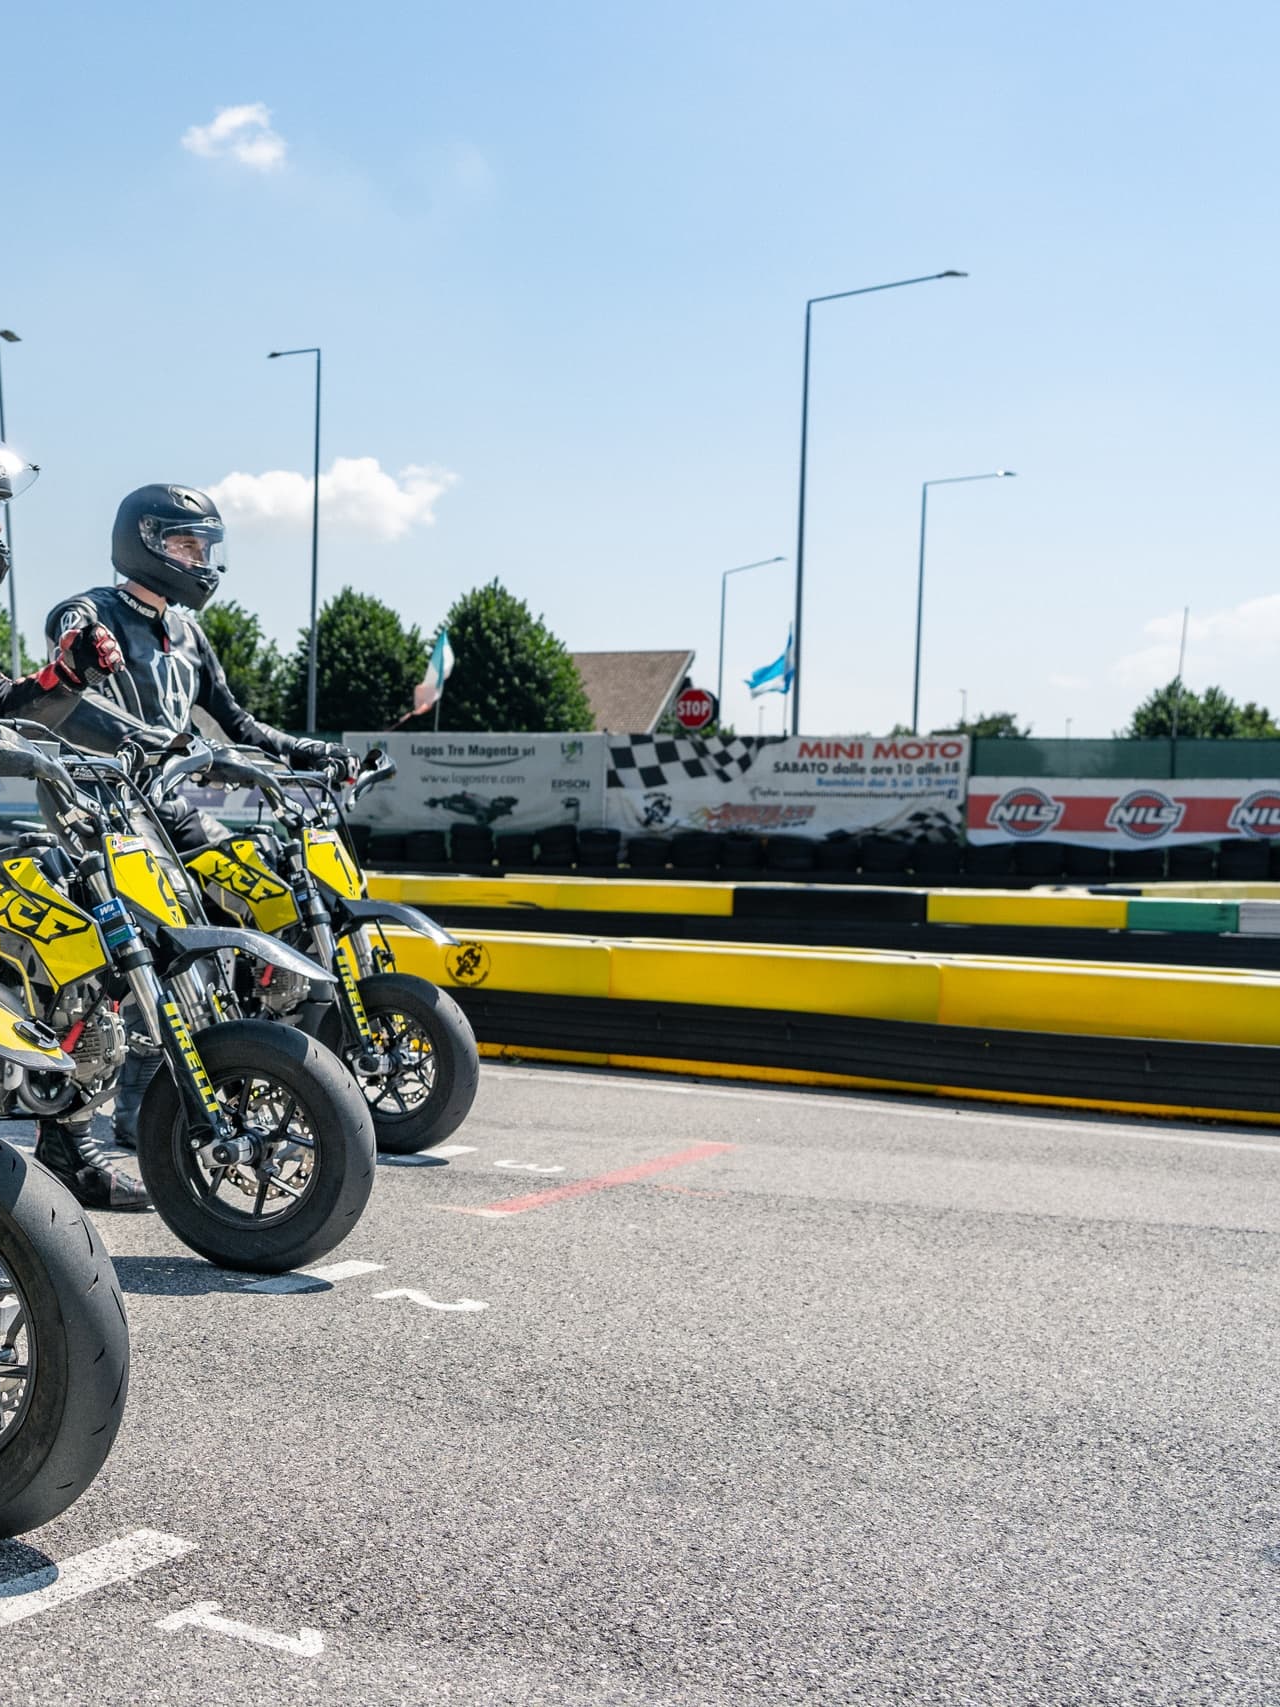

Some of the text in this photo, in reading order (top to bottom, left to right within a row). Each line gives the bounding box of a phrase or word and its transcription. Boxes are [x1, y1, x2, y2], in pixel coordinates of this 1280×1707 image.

[677, 700, 710, 716] STOP
[411, 744, 535, 759] Logos Tre Magenta srl
[798, 742, 964, 759] MINI MOTO
[773, 762, 829, 774] SABATO
[832, 763, 866, 775] dalle
[871, 765, 893, 775] ore
[897, 764, 913, 775] 10
[916, 763, 942, 774] alle
[421, 772, 525, 786] www.logostre.com
[551, 779, 590, 790] EPSON
[994, 804, 1280, 824] NILS NILS NIL
[334, 848, 353, 885] 1
[146, 855, 176, 907] 2
[163, 1002, 219, 1113] PIRELLI
